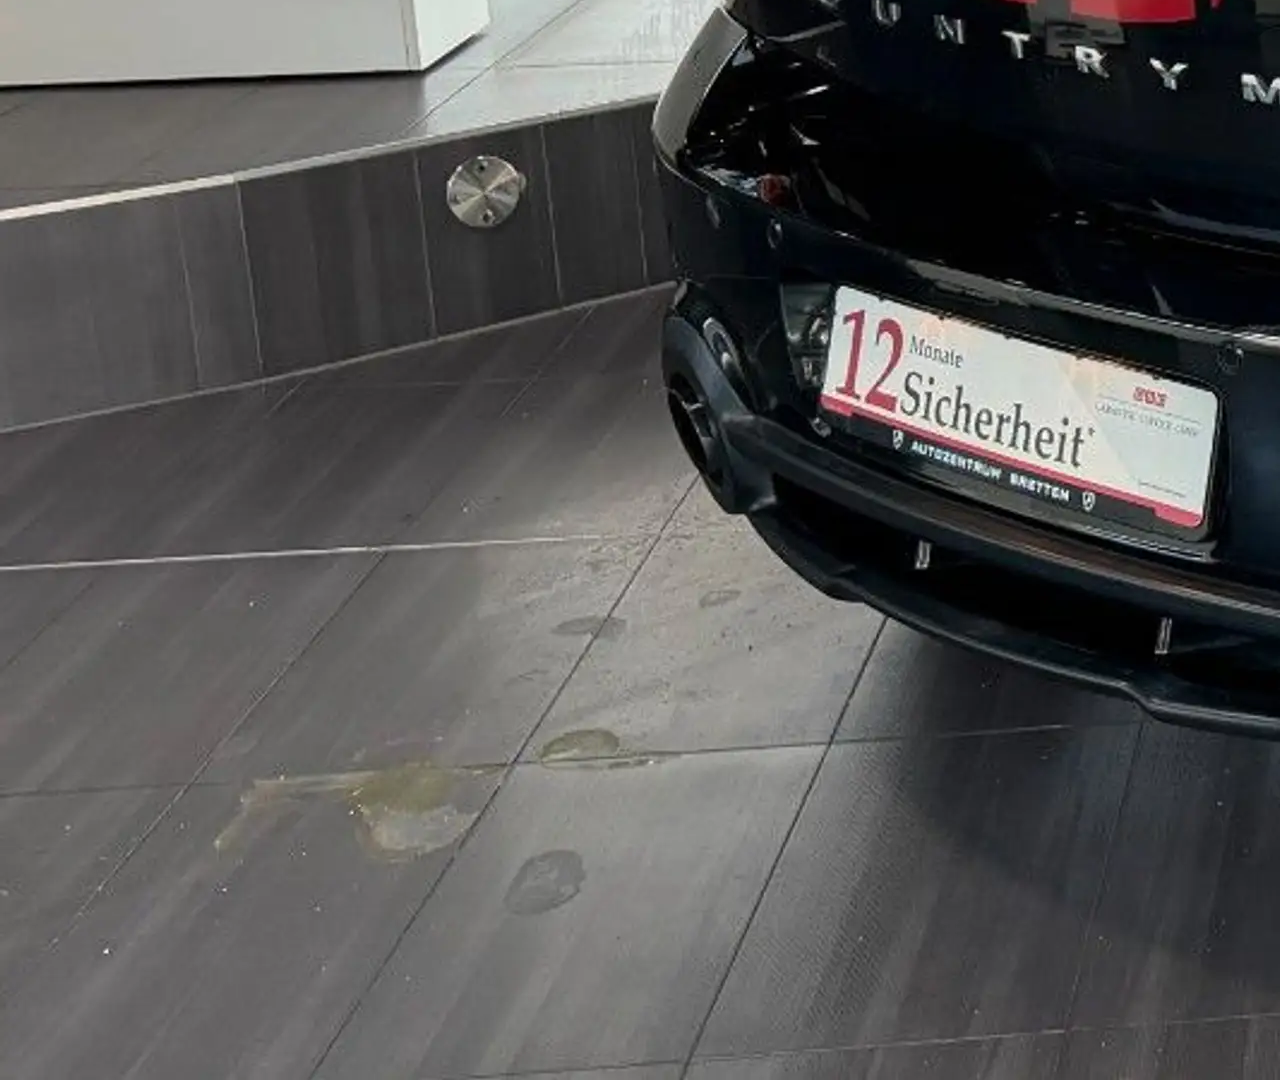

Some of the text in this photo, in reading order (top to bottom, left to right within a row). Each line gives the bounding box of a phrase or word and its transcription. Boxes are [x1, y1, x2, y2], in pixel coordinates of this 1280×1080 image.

[837, 309, 964, 414] 12 Monate
[912, 440, 1070, 502] AUTOZENTRUM BRETTEN
